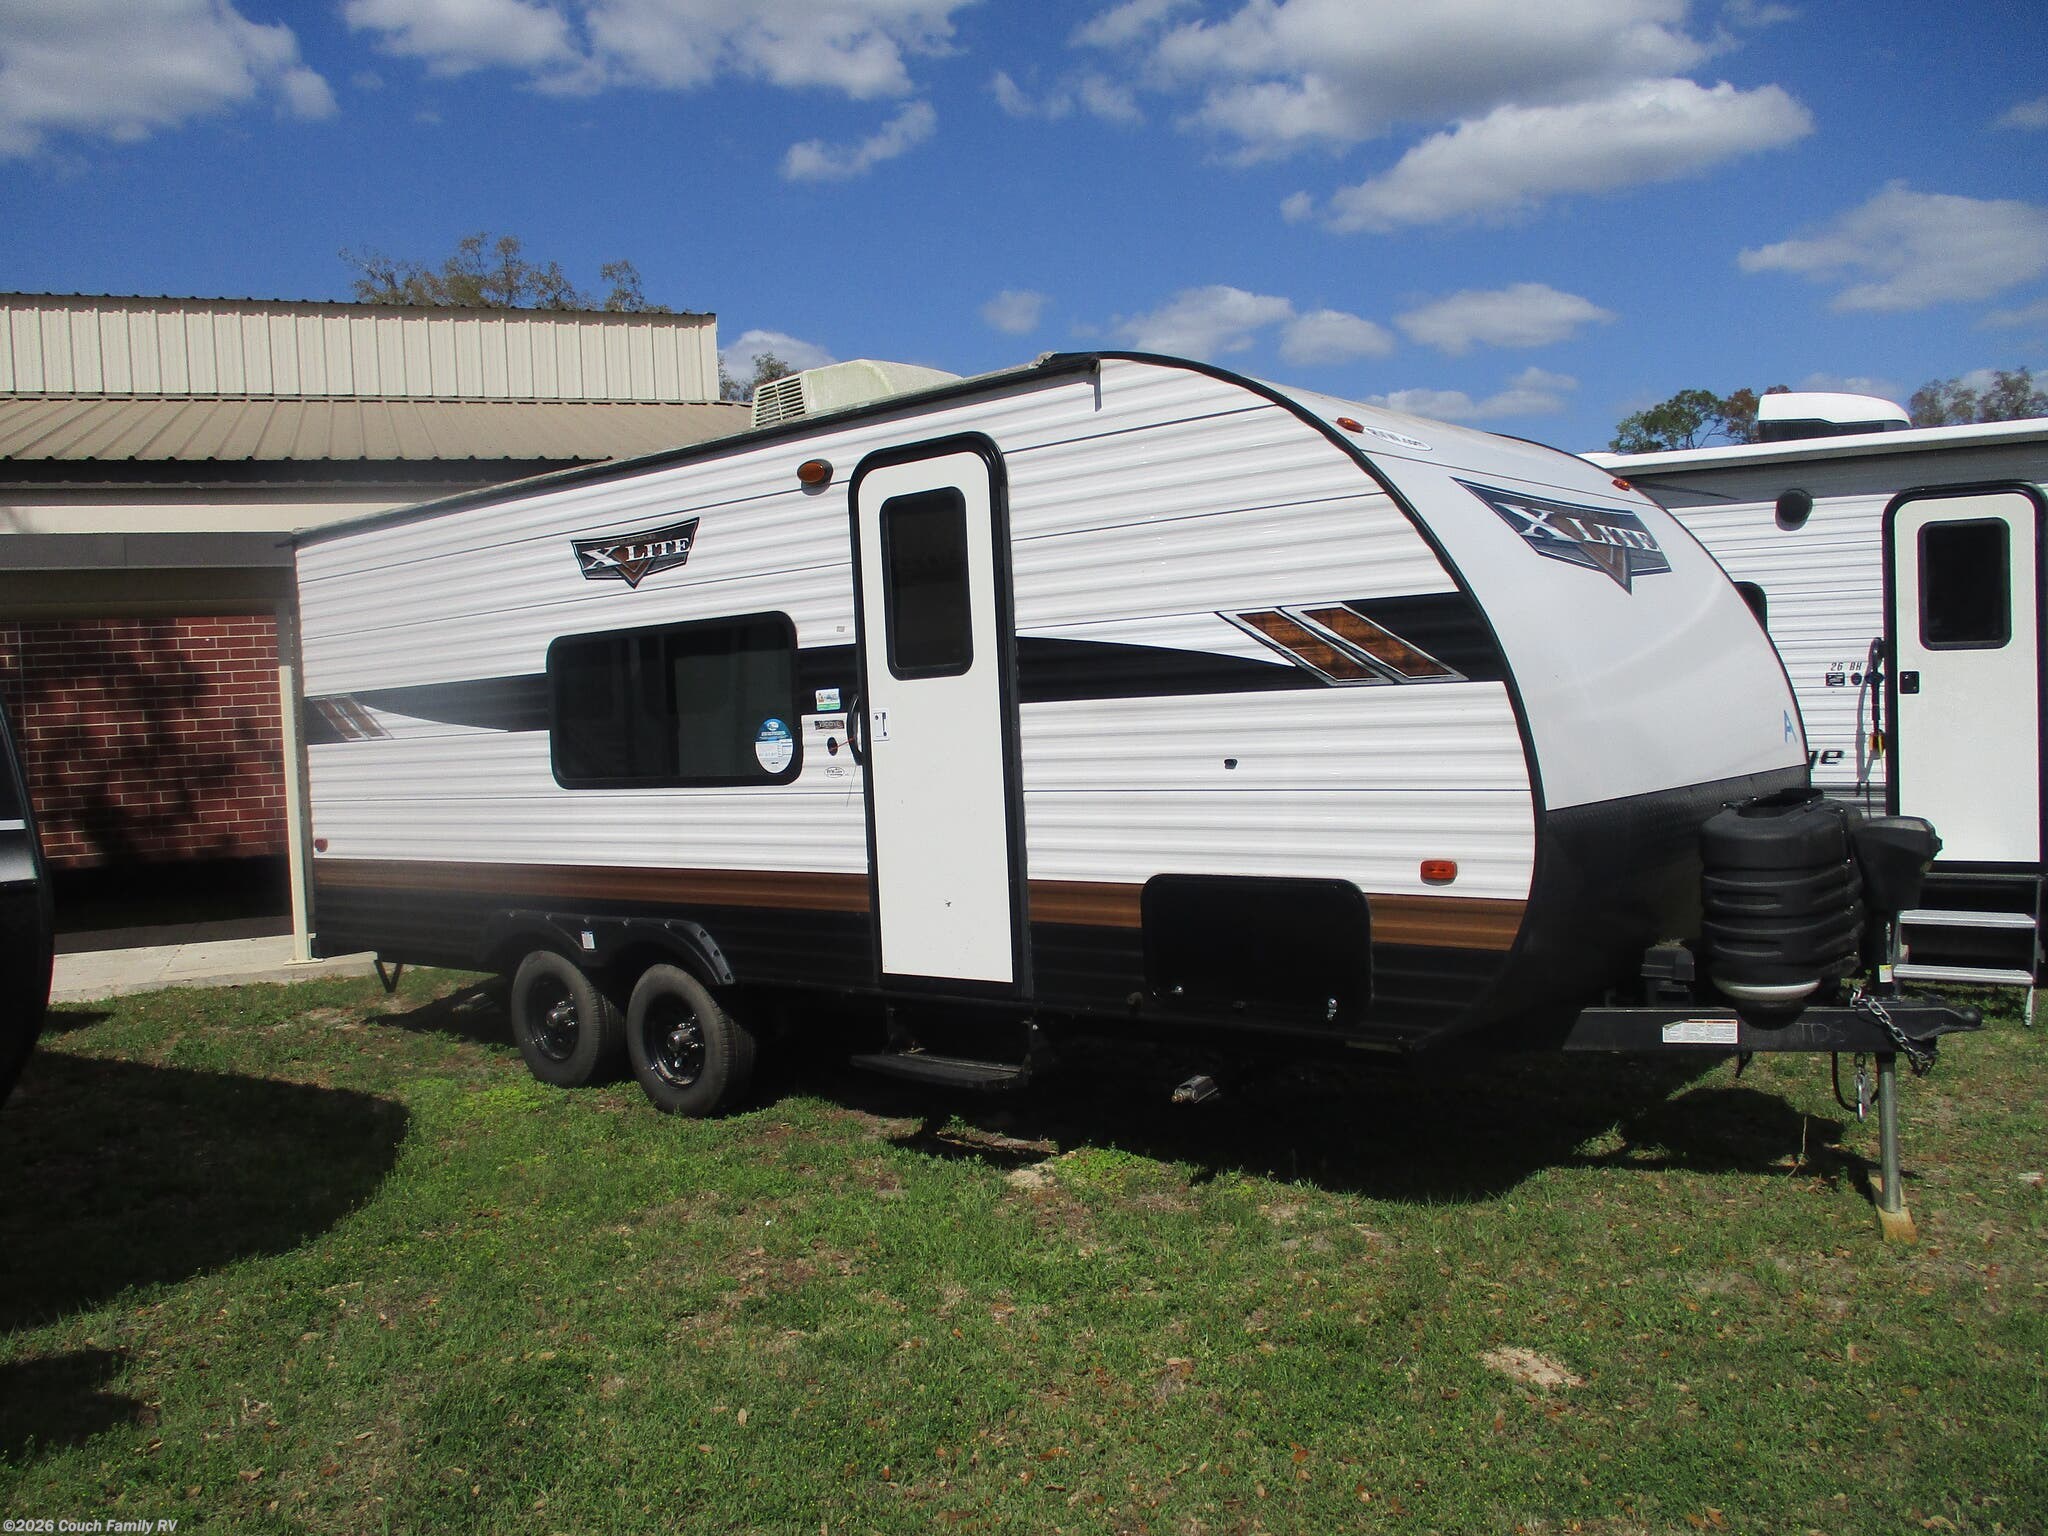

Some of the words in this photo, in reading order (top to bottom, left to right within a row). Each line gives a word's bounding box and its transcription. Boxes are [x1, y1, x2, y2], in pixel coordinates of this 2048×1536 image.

[1494, 502, 1581, 543] X
[1566, 517, 1661, 552] LITE
[582, 545, 621, 570] X
[625, 537, 690, 562] LITE
[1783, 710, 1798, 743] A
